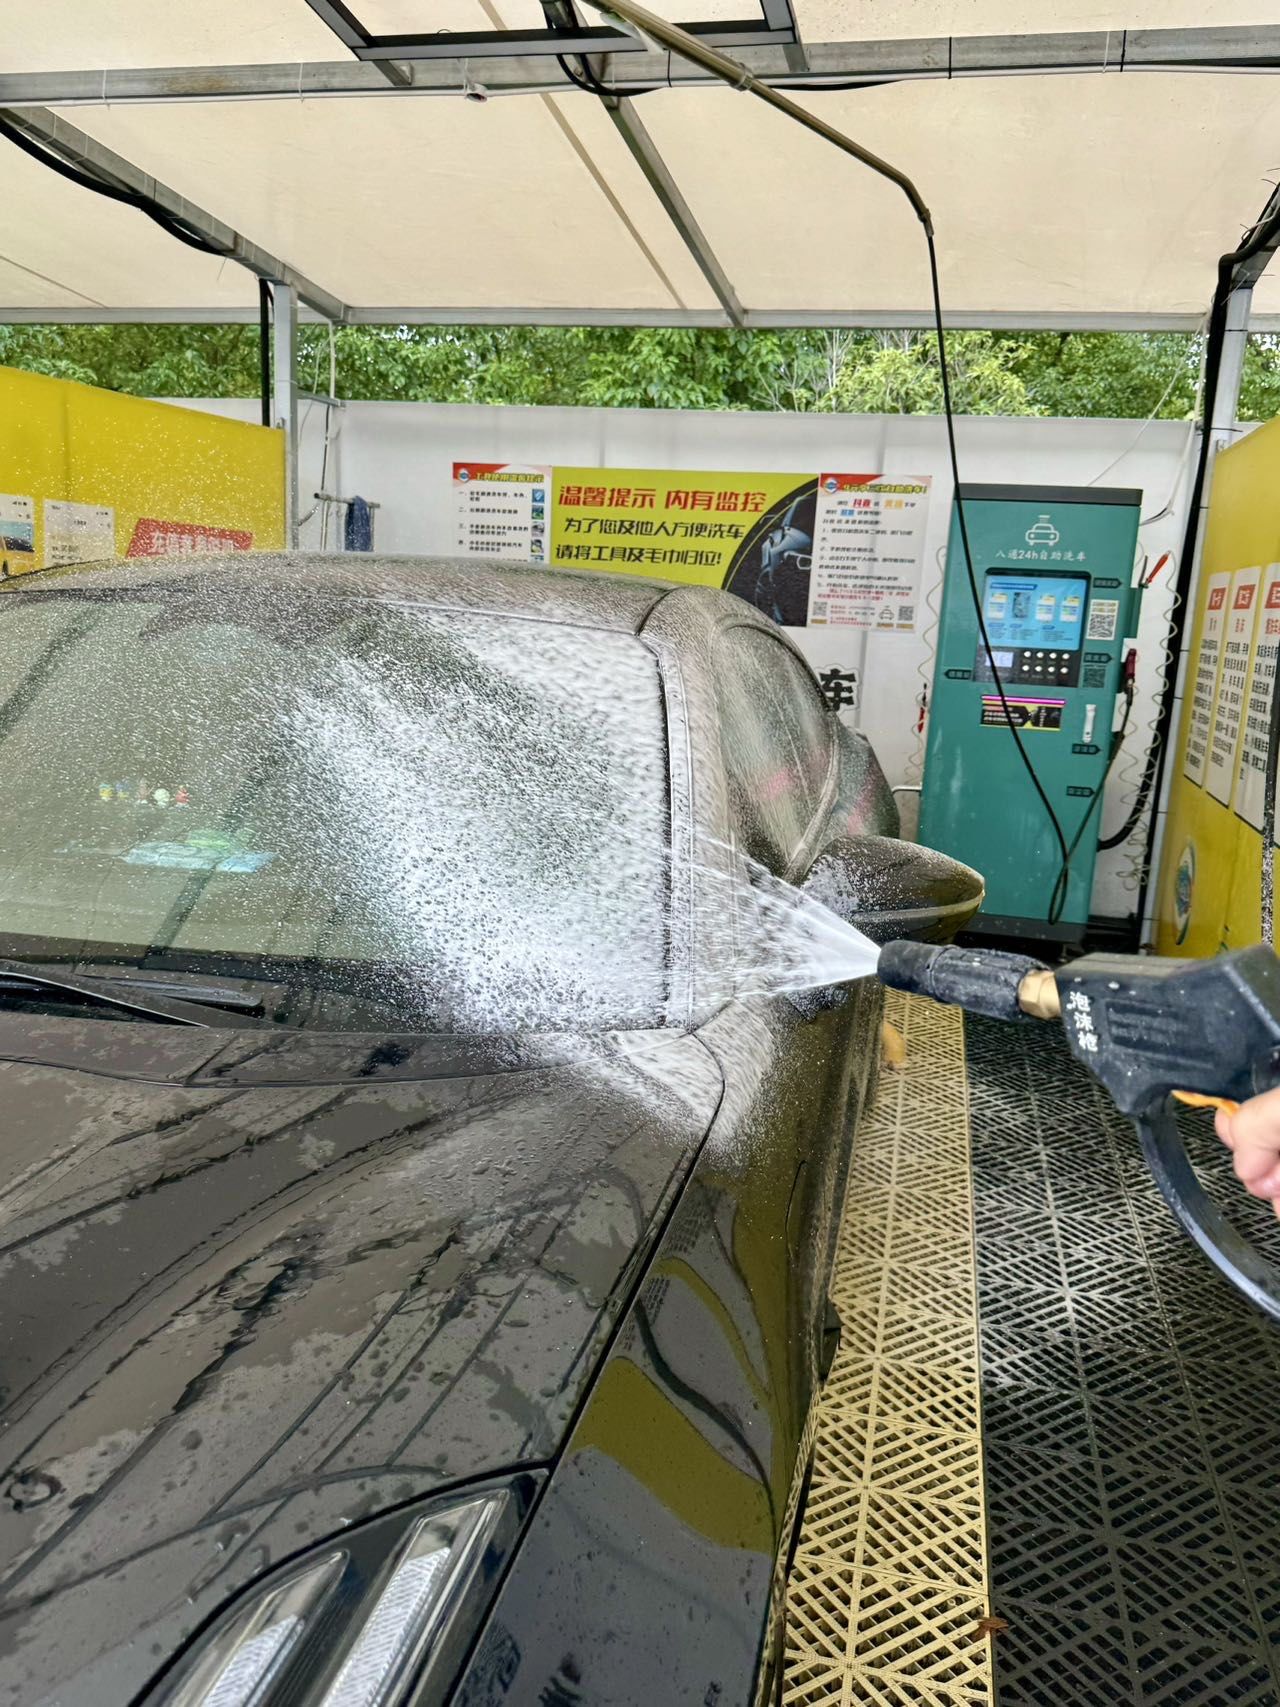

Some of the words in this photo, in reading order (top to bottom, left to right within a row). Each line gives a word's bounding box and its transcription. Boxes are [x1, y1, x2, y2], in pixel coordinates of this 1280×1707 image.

[558, 485, 658, 509] 温馨提示
[664, 489, 768, 513] 内有监控
[564, 517, 746, 539] 为了您及他人方便洗车
[818, 667, 857, 712] 车
